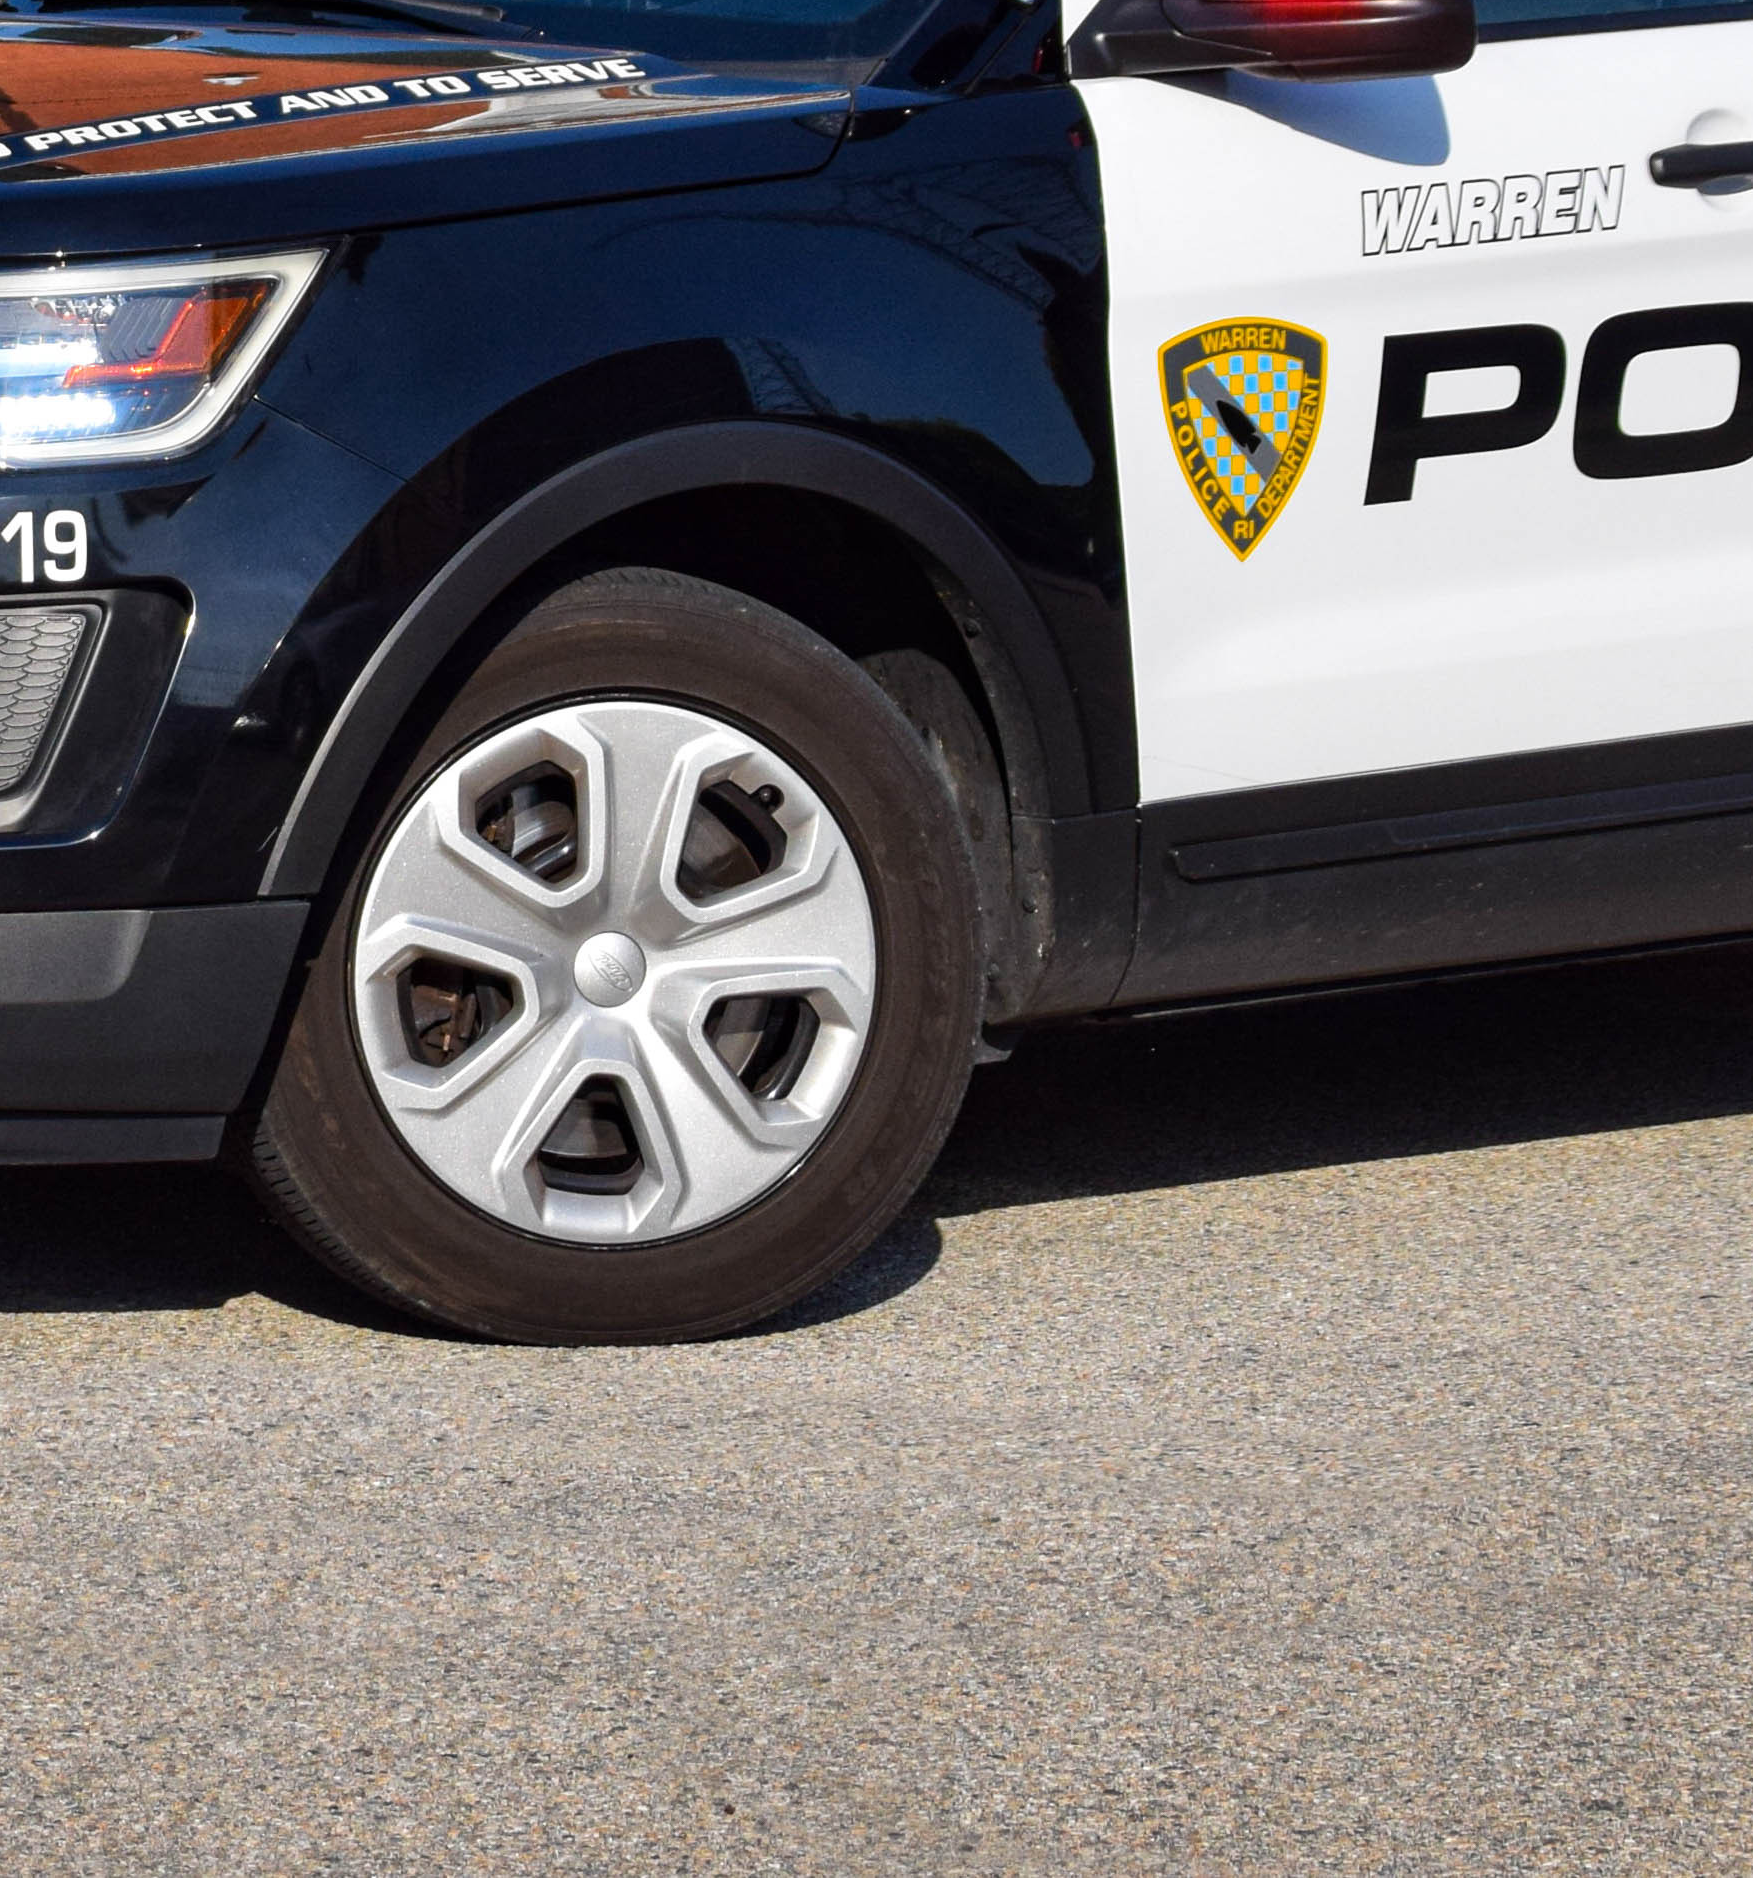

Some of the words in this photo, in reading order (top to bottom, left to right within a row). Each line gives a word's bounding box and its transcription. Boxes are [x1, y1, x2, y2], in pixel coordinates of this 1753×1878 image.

[24, 100, 260, 151] PROTECT
[277, 83, 388, 116] AND
[393, 74, 471, 99] TO
[477, 58, 646, 91] SERVE
[1360, 164, 1625, 257] WARREN
[1201, 328, 1286, 354] WARREN
[1170, 401, 1230, 521] POLICE
[1256, 373, 1320, 519] DEPARTMENT
[1233, 520, 1254, 539] RI
